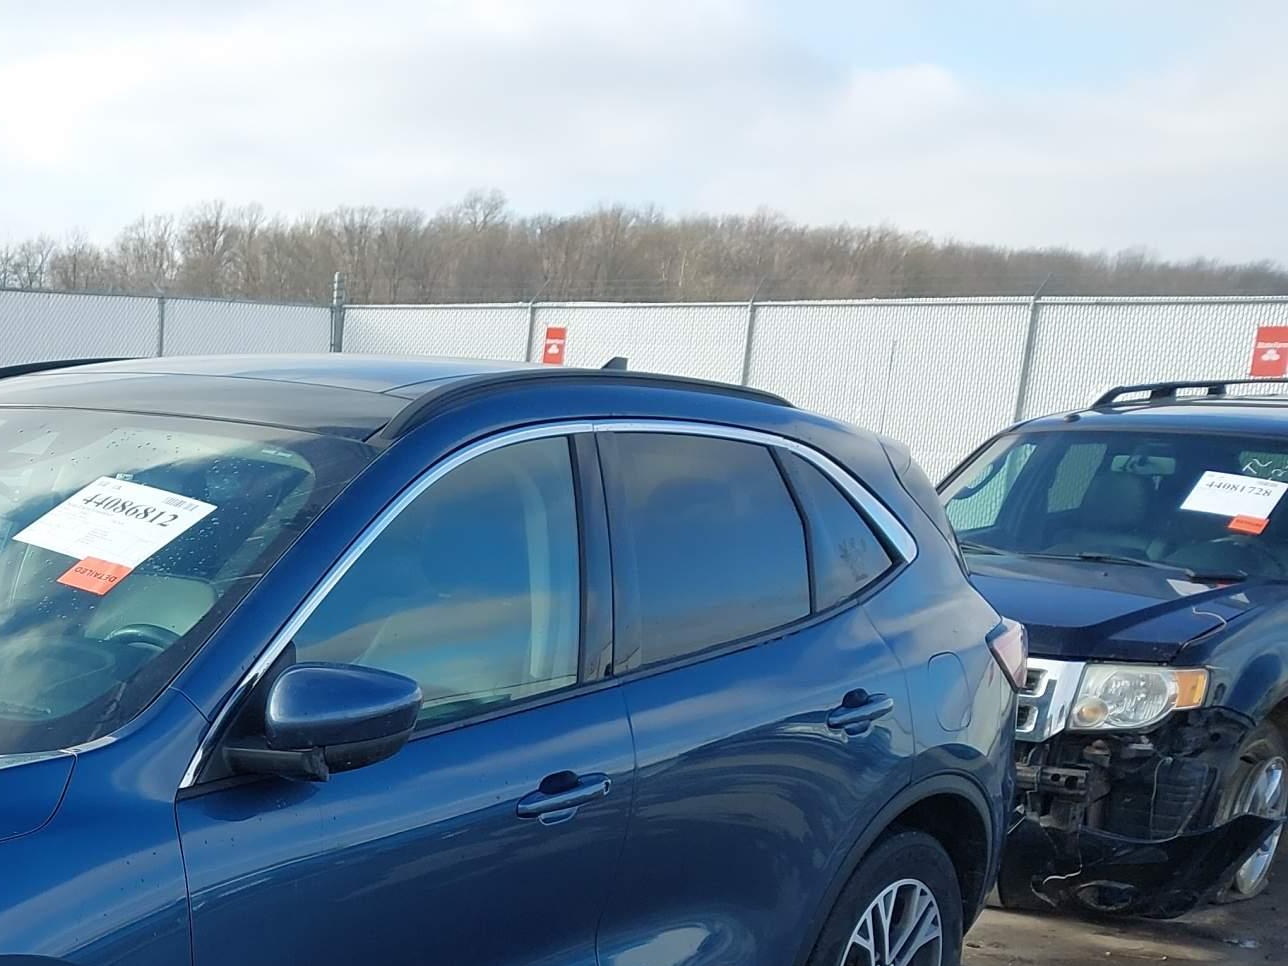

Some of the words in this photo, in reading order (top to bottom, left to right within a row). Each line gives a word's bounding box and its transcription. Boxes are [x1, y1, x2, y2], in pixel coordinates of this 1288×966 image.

[1206, 481, 1273, 497] 44081728
[82, 493, 179, 527] 44086812
[74, 566, 118, 583] DETAILED
